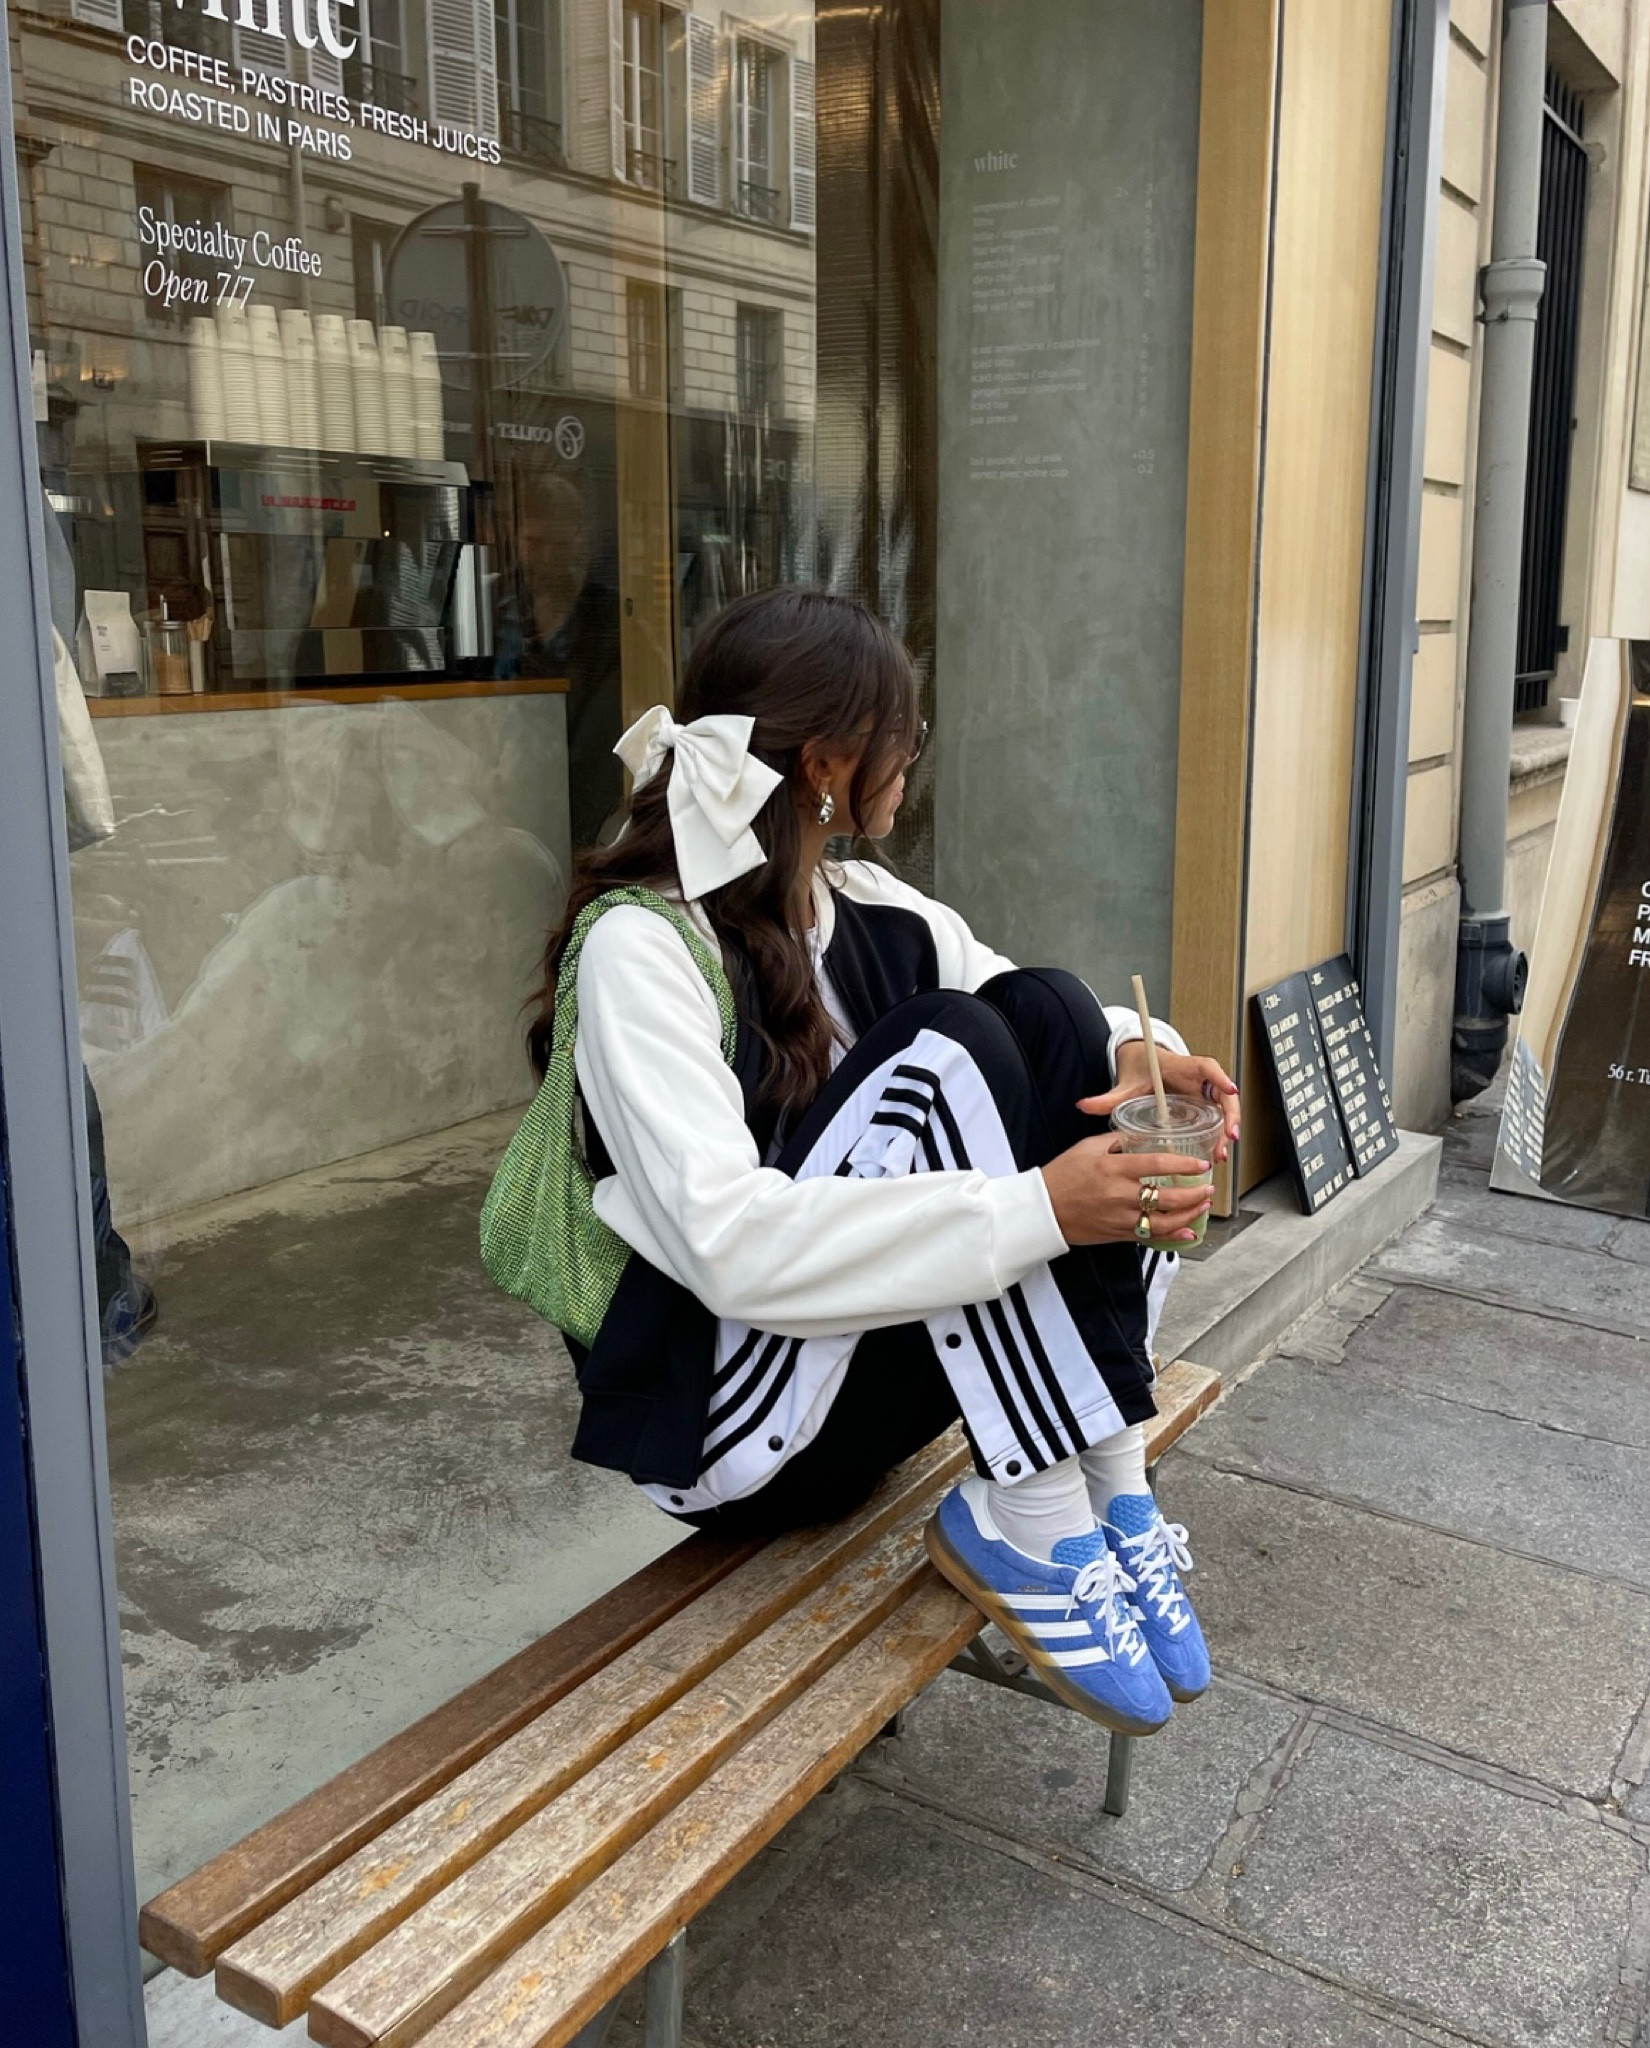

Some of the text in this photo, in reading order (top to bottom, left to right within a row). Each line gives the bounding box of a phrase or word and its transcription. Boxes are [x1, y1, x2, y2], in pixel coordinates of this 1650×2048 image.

[127, 35, 501, 165] COFFEE, PASTRIES, FRESH JUICES
[130, 77, 352, 161] ROASTED IN PARIS
[139, 206, 322, 277] Specialty Coffee
[144, 260, 255, 310] Open 7/7
[1607, 1063, 1625, 1079] 56
